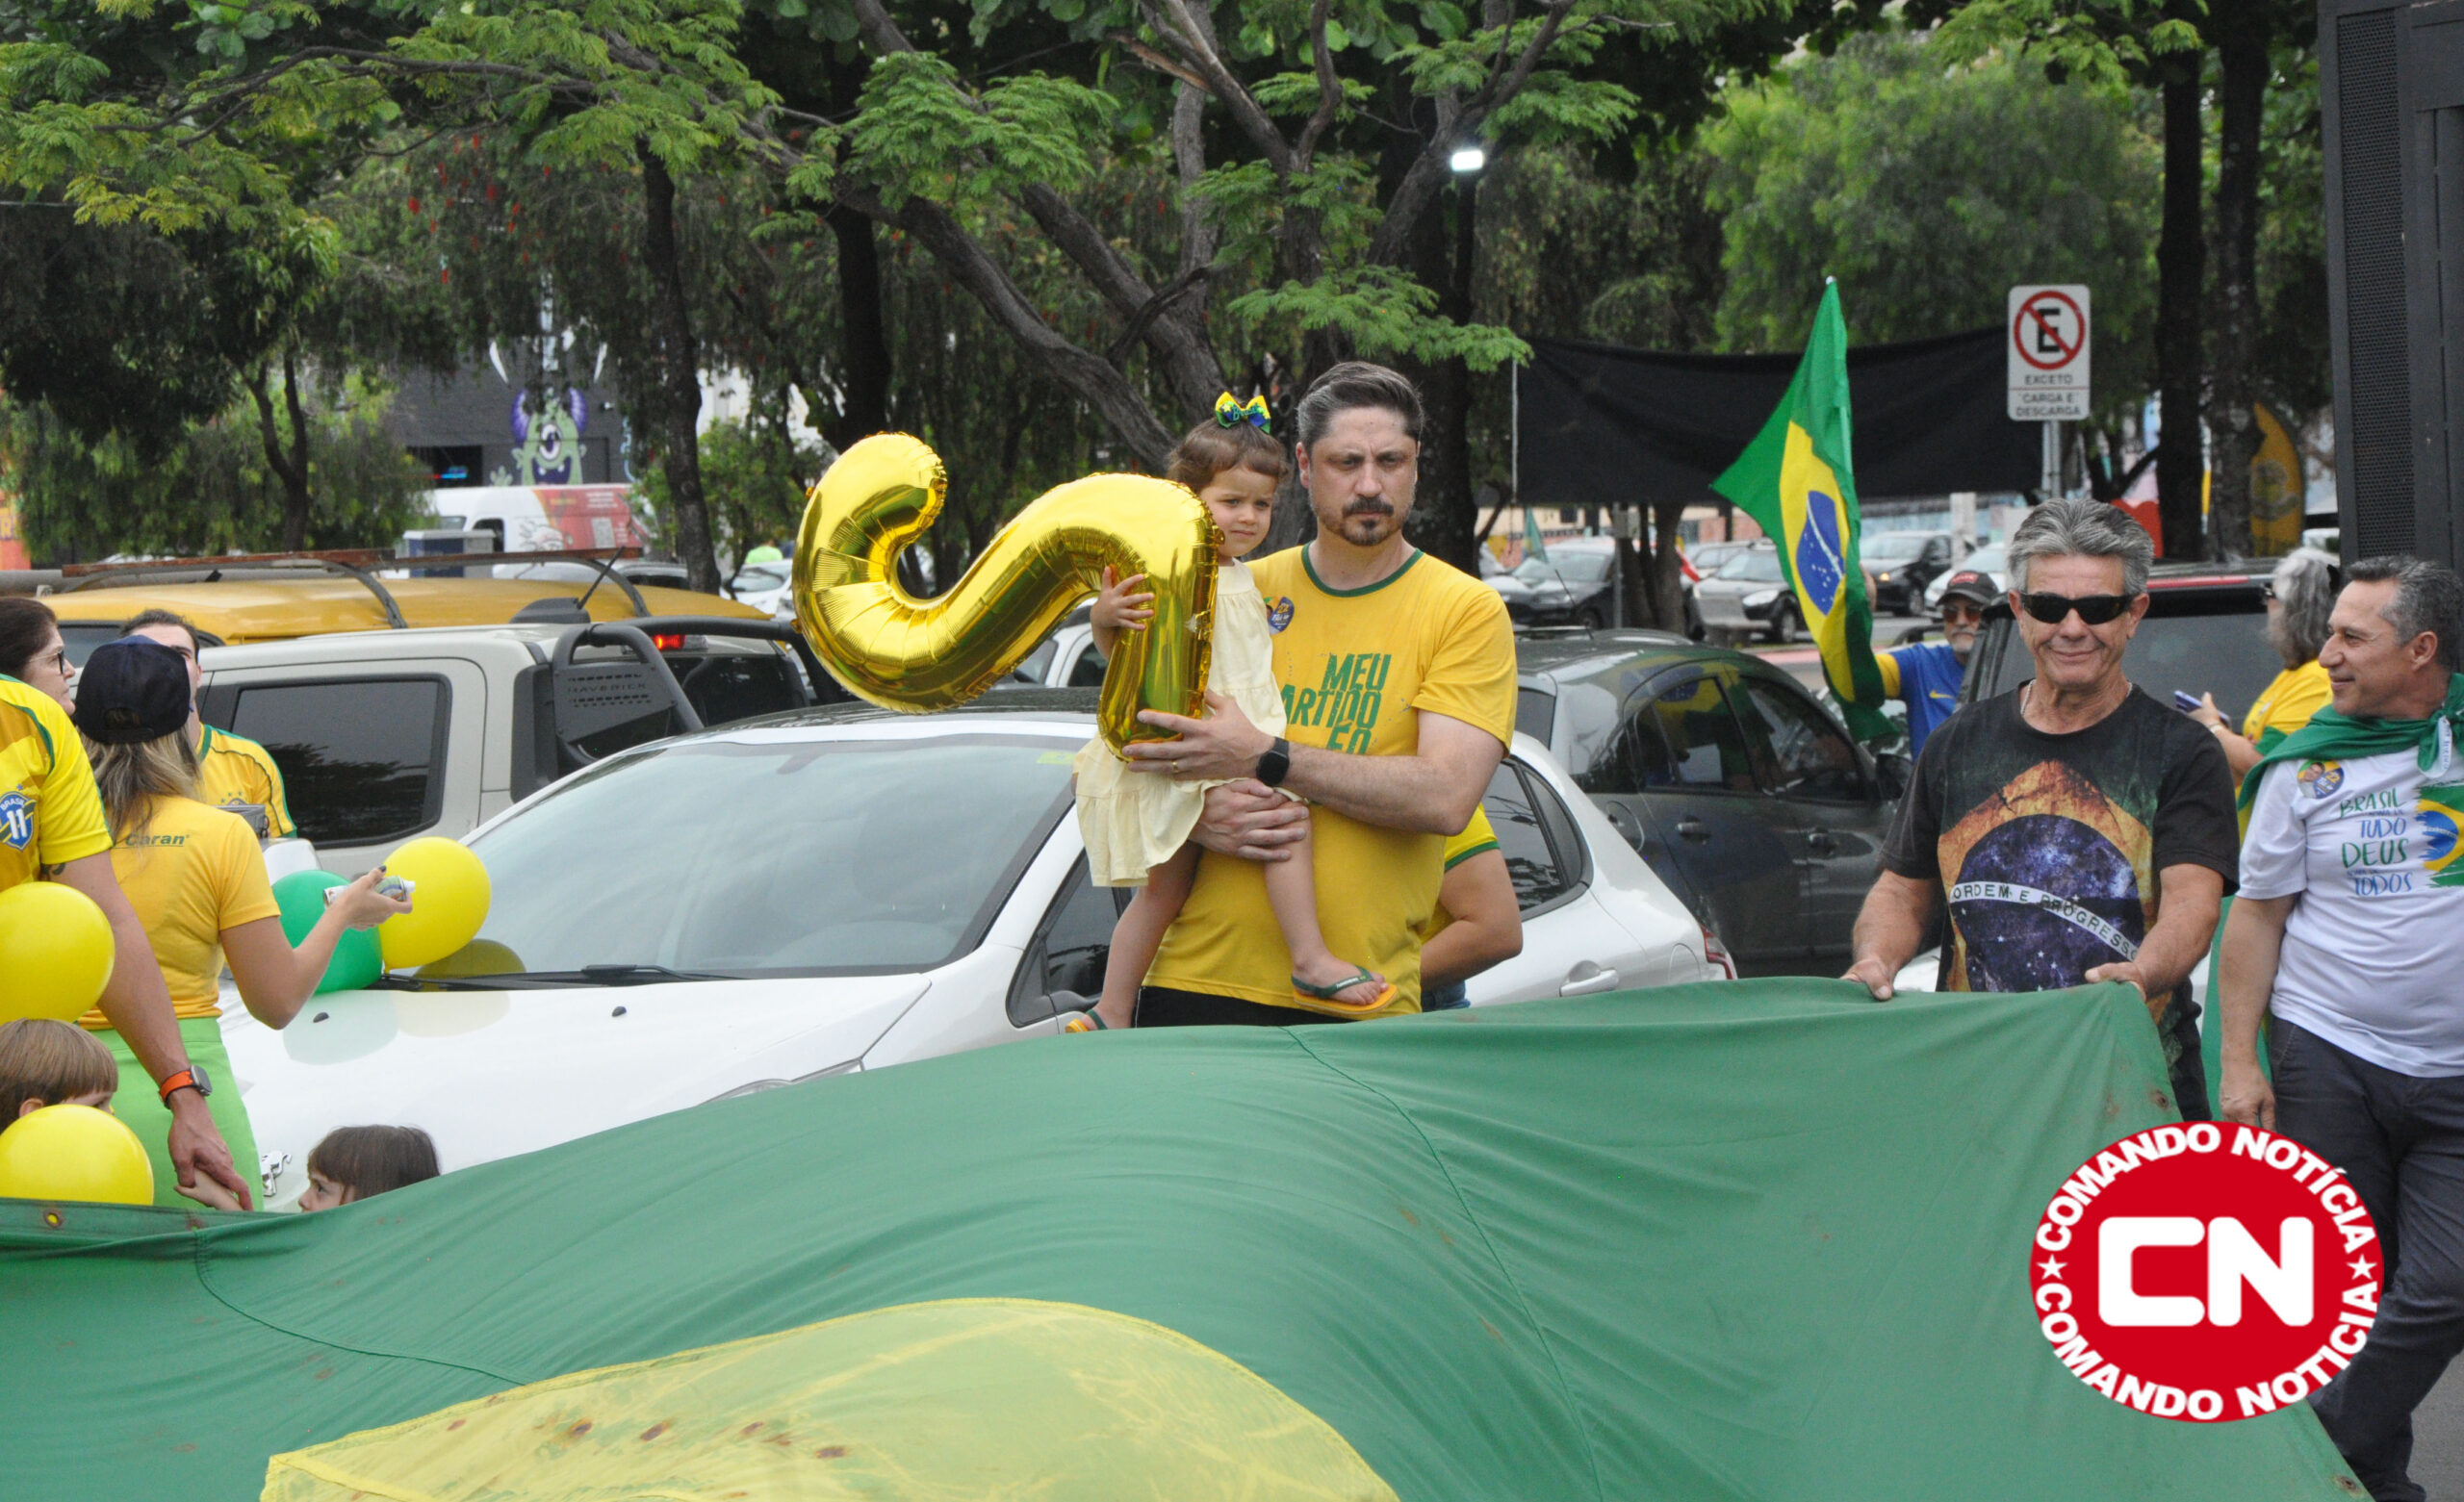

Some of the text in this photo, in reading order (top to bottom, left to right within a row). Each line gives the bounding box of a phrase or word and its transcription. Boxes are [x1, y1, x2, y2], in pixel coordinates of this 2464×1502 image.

[2039, 308, 2061, 353] E
[2024, 373, 2073, 385] EXCETO
[2022, 392, 2074, 403] CARGA E
[2015, 406, 2081, 417] DESCARGA
[1321, 652, 1392, 691] MEU
[568, 683, 647, 693] MAVERICK
[1279, 684, 1382, 728] ARTIDO
[2340, 788, 2407, 818] BRASIL
[7, 808, 28, 839] 11
[2358, 817, 2407, 839] TUDO
[2342, 838, 2409, 869] DEUS
[1953, 883, 2010, 899] ORDEM
[2019, 889, 2030, 903] E
[2349, 871, 2413, 896] TODOS
